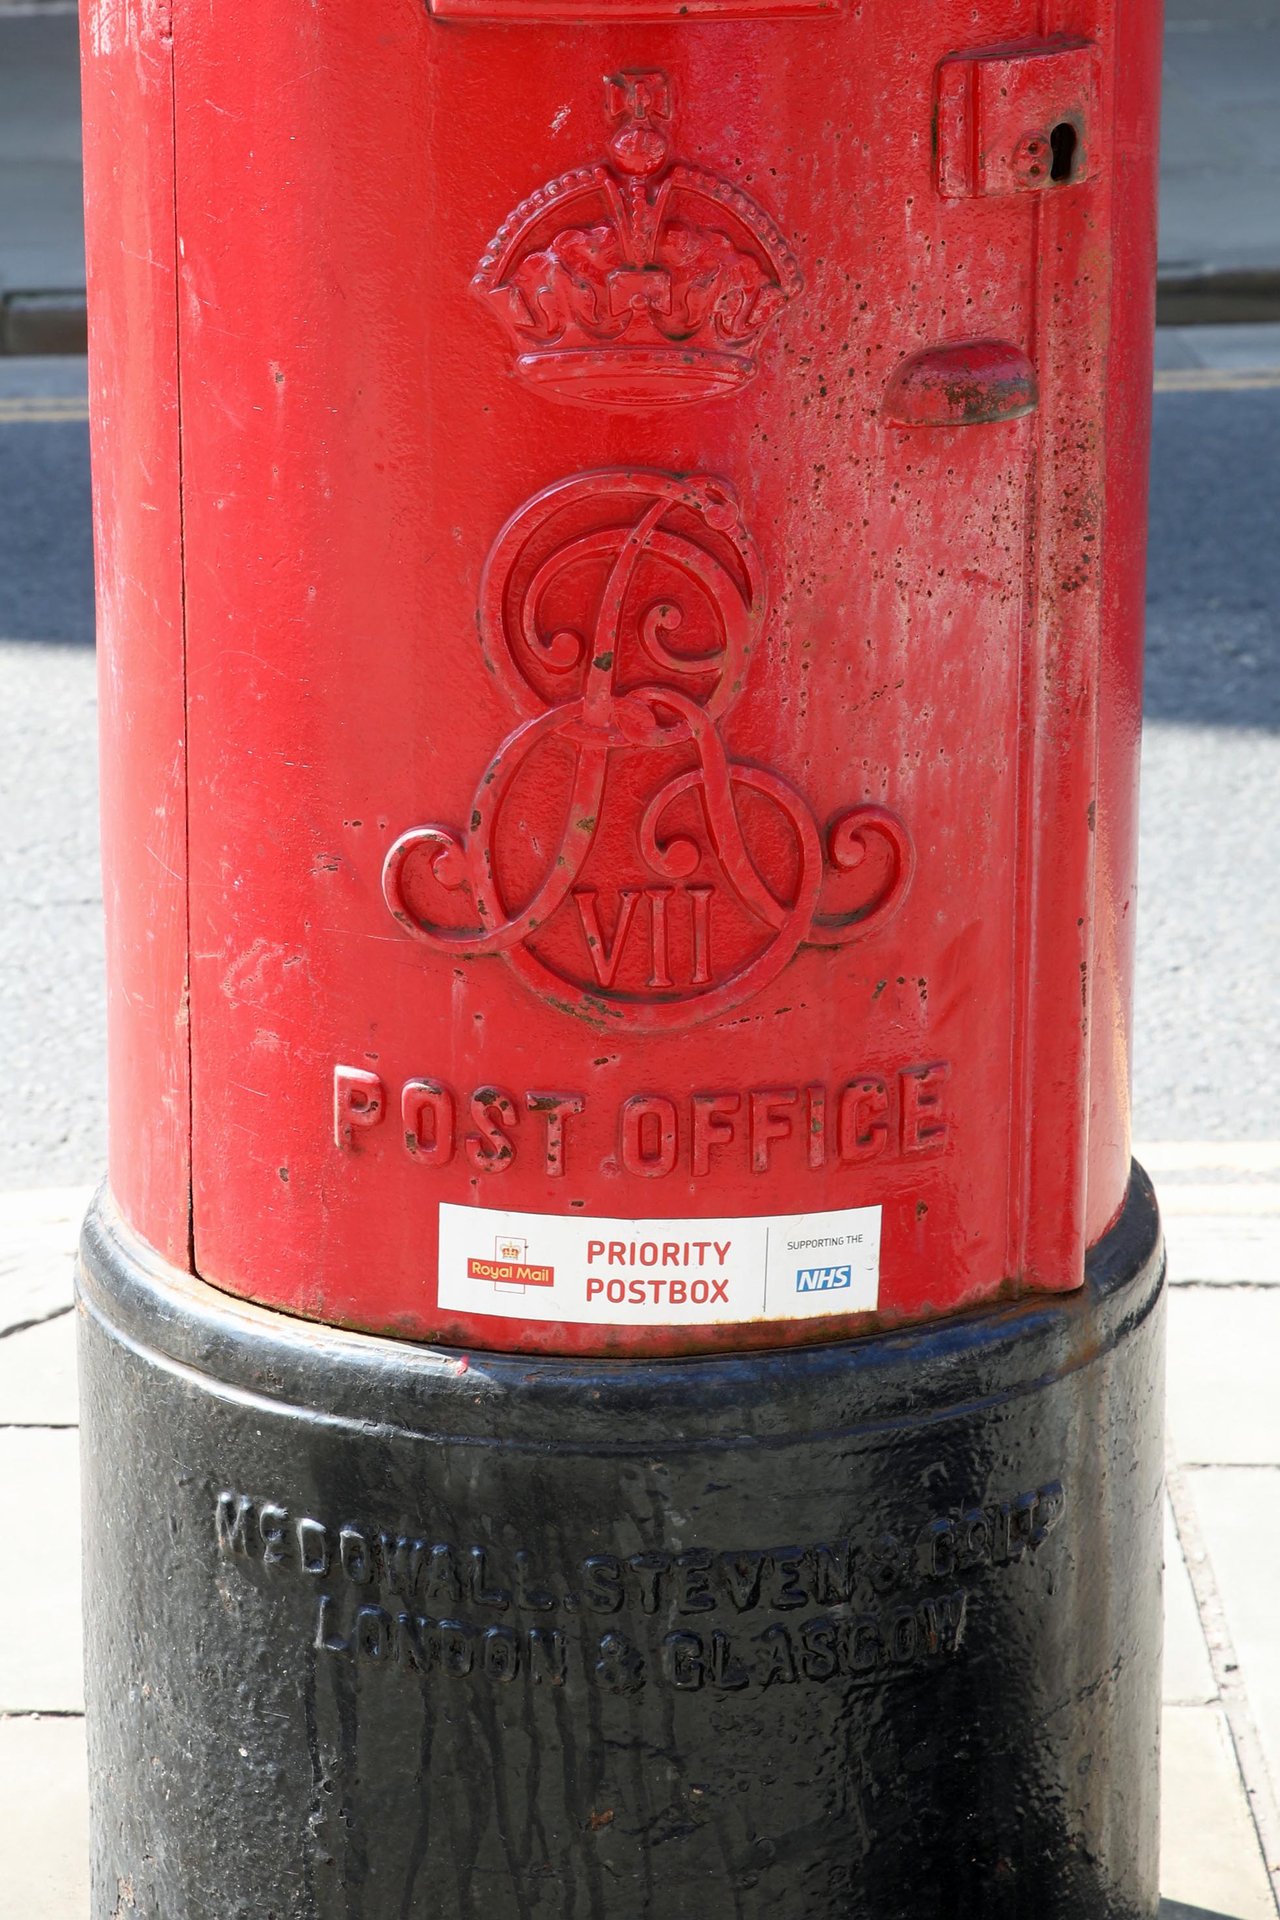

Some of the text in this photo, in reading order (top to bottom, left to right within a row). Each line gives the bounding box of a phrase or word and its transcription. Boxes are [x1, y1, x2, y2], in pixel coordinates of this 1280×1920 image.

[573, 887, 716, 988] VII
[333, 1061, 950, 1178] POST OFFICE
[587, 1240, 732, 1267] PRIORITY
[787, 1234, 863, 1250] SUPPORTING THE
[471, 1261, 549, 1283] Royal Mail
[798, 1266, 850, 1291] NHS
[585, 1278, 730, 1304] POSTBOX
[314, 1589, 967, 1692] LONDON & GLASGOW
